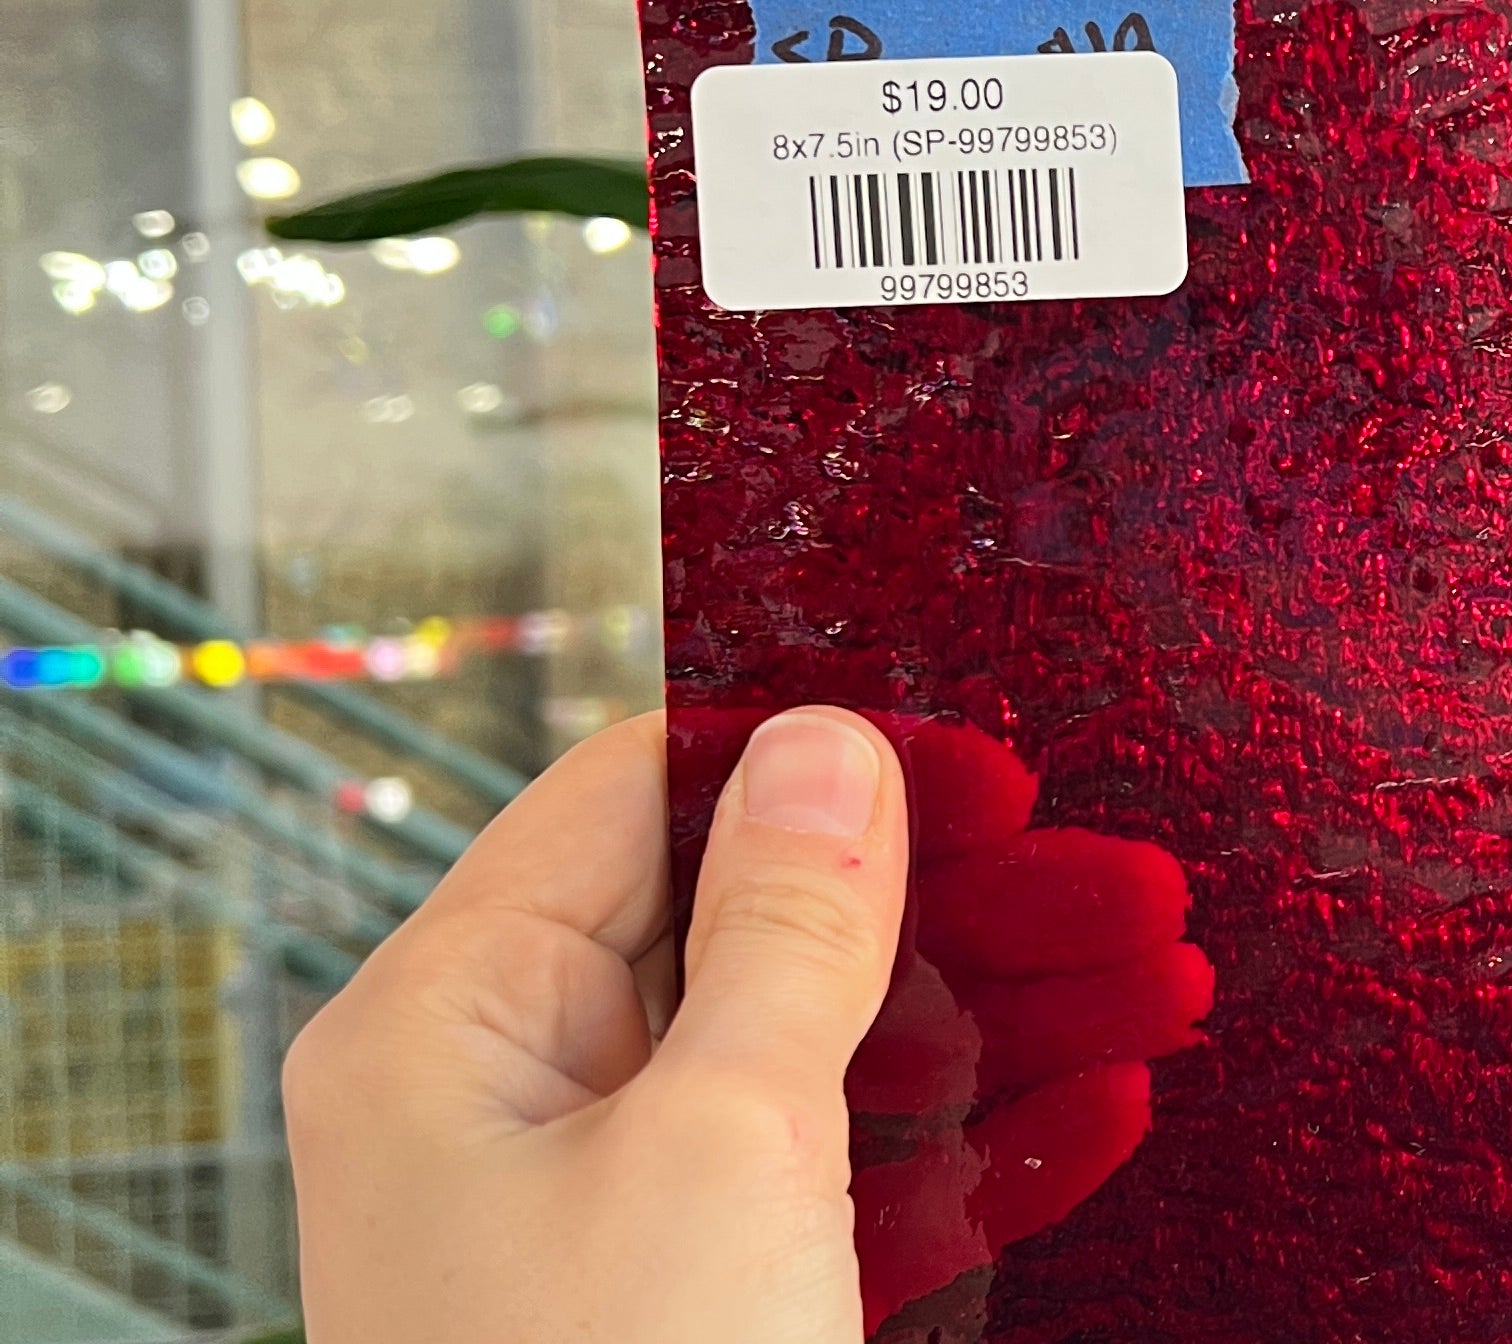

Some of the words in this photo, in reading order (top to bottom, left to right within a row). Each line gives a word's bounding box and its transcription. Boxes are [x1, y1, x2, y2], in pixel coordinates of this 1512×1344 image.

[882, 77, 1004, 115] $19.00
[773, 131, 880, 161] 8x7.5in
[892, 123, 1117, 163] (SP-99799853)
[880, 272, 1030, 302] 99799853
